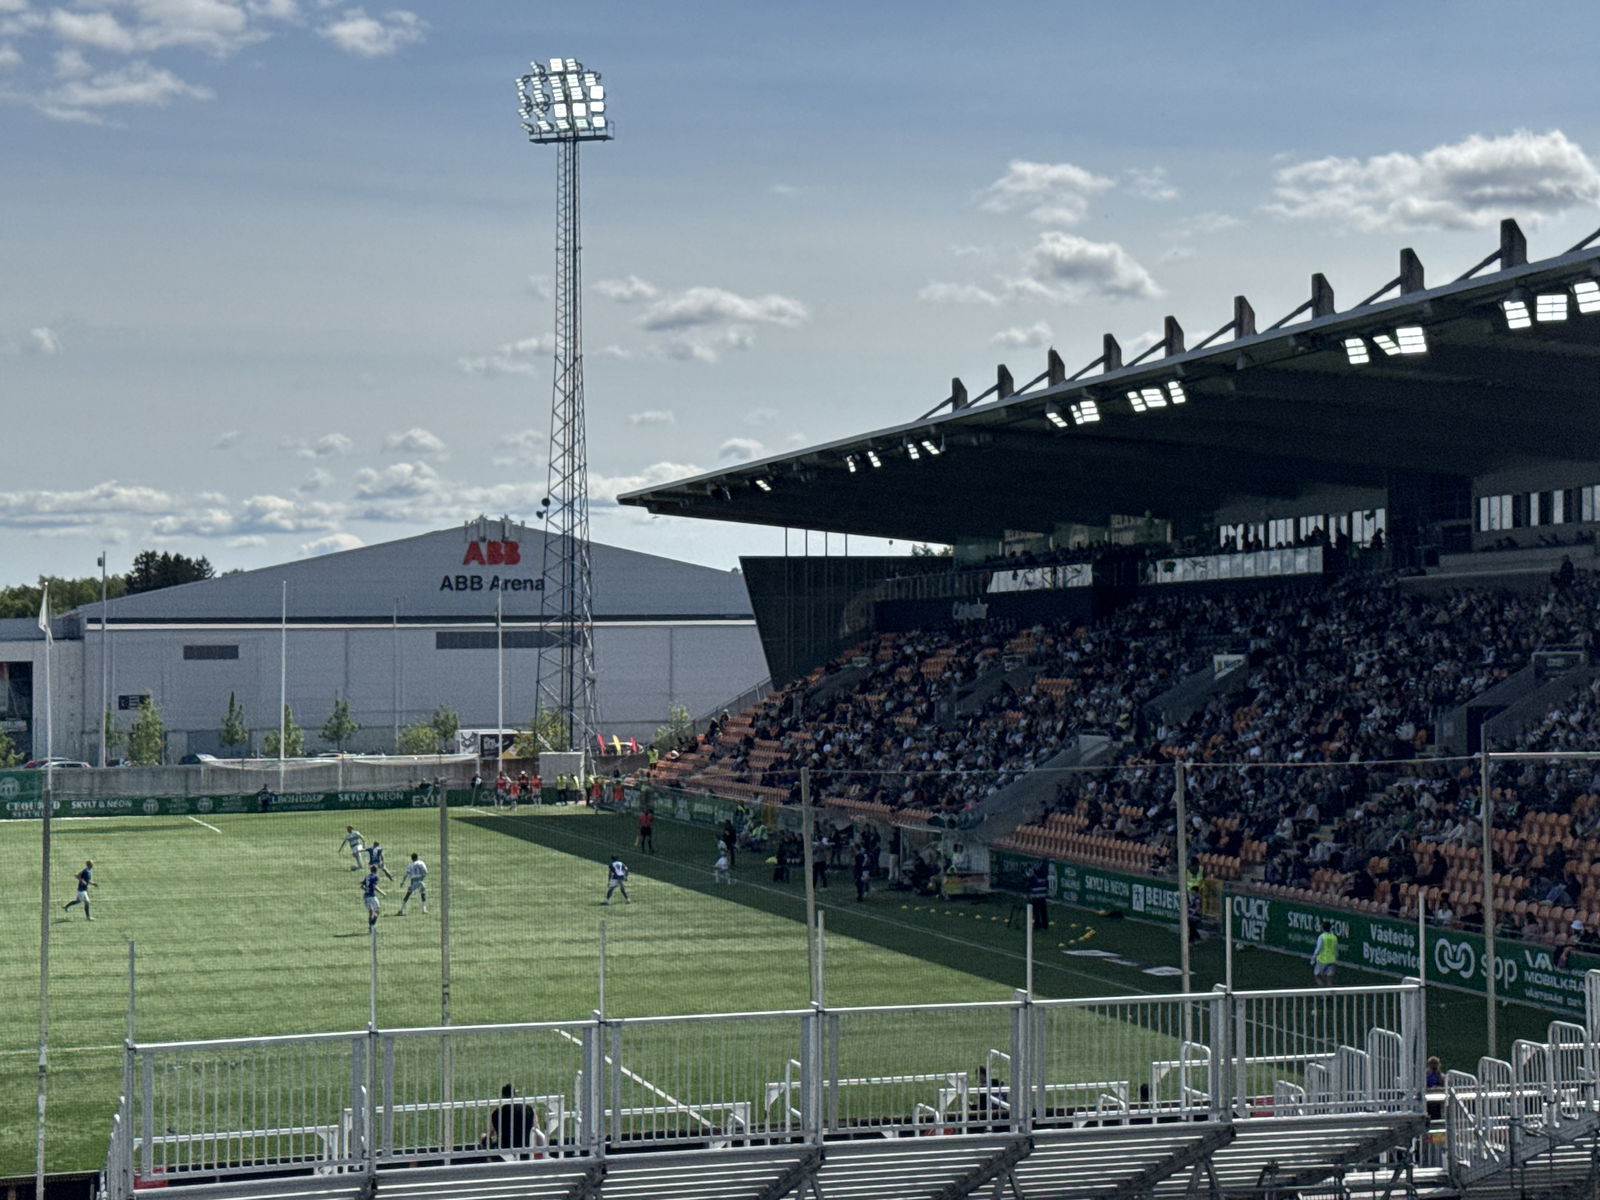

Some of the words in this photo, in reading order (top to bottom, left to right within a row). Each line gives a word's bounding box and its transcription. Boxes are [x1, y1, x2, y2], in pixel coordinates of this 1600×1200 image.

[462, 541, 521, 565] ABB
[440, 575, 483, 591] ABB
[489, 575, 545, 592] Arena
[71, 801, 96, 809] SKYLT
[106, 800, 132, 808] NEON
[338, 793, 364, 802] SKYLT
[377, 791, 404, 801] NEON
[1233, 896, 1270, 921] QUICK
[1241, 918, 1267, 942] NET
[1287, 911, 1313, 931] SKYLT
[1314, 915, 1321, 932] &
[1370, 923, 1415, 948] Västerås
